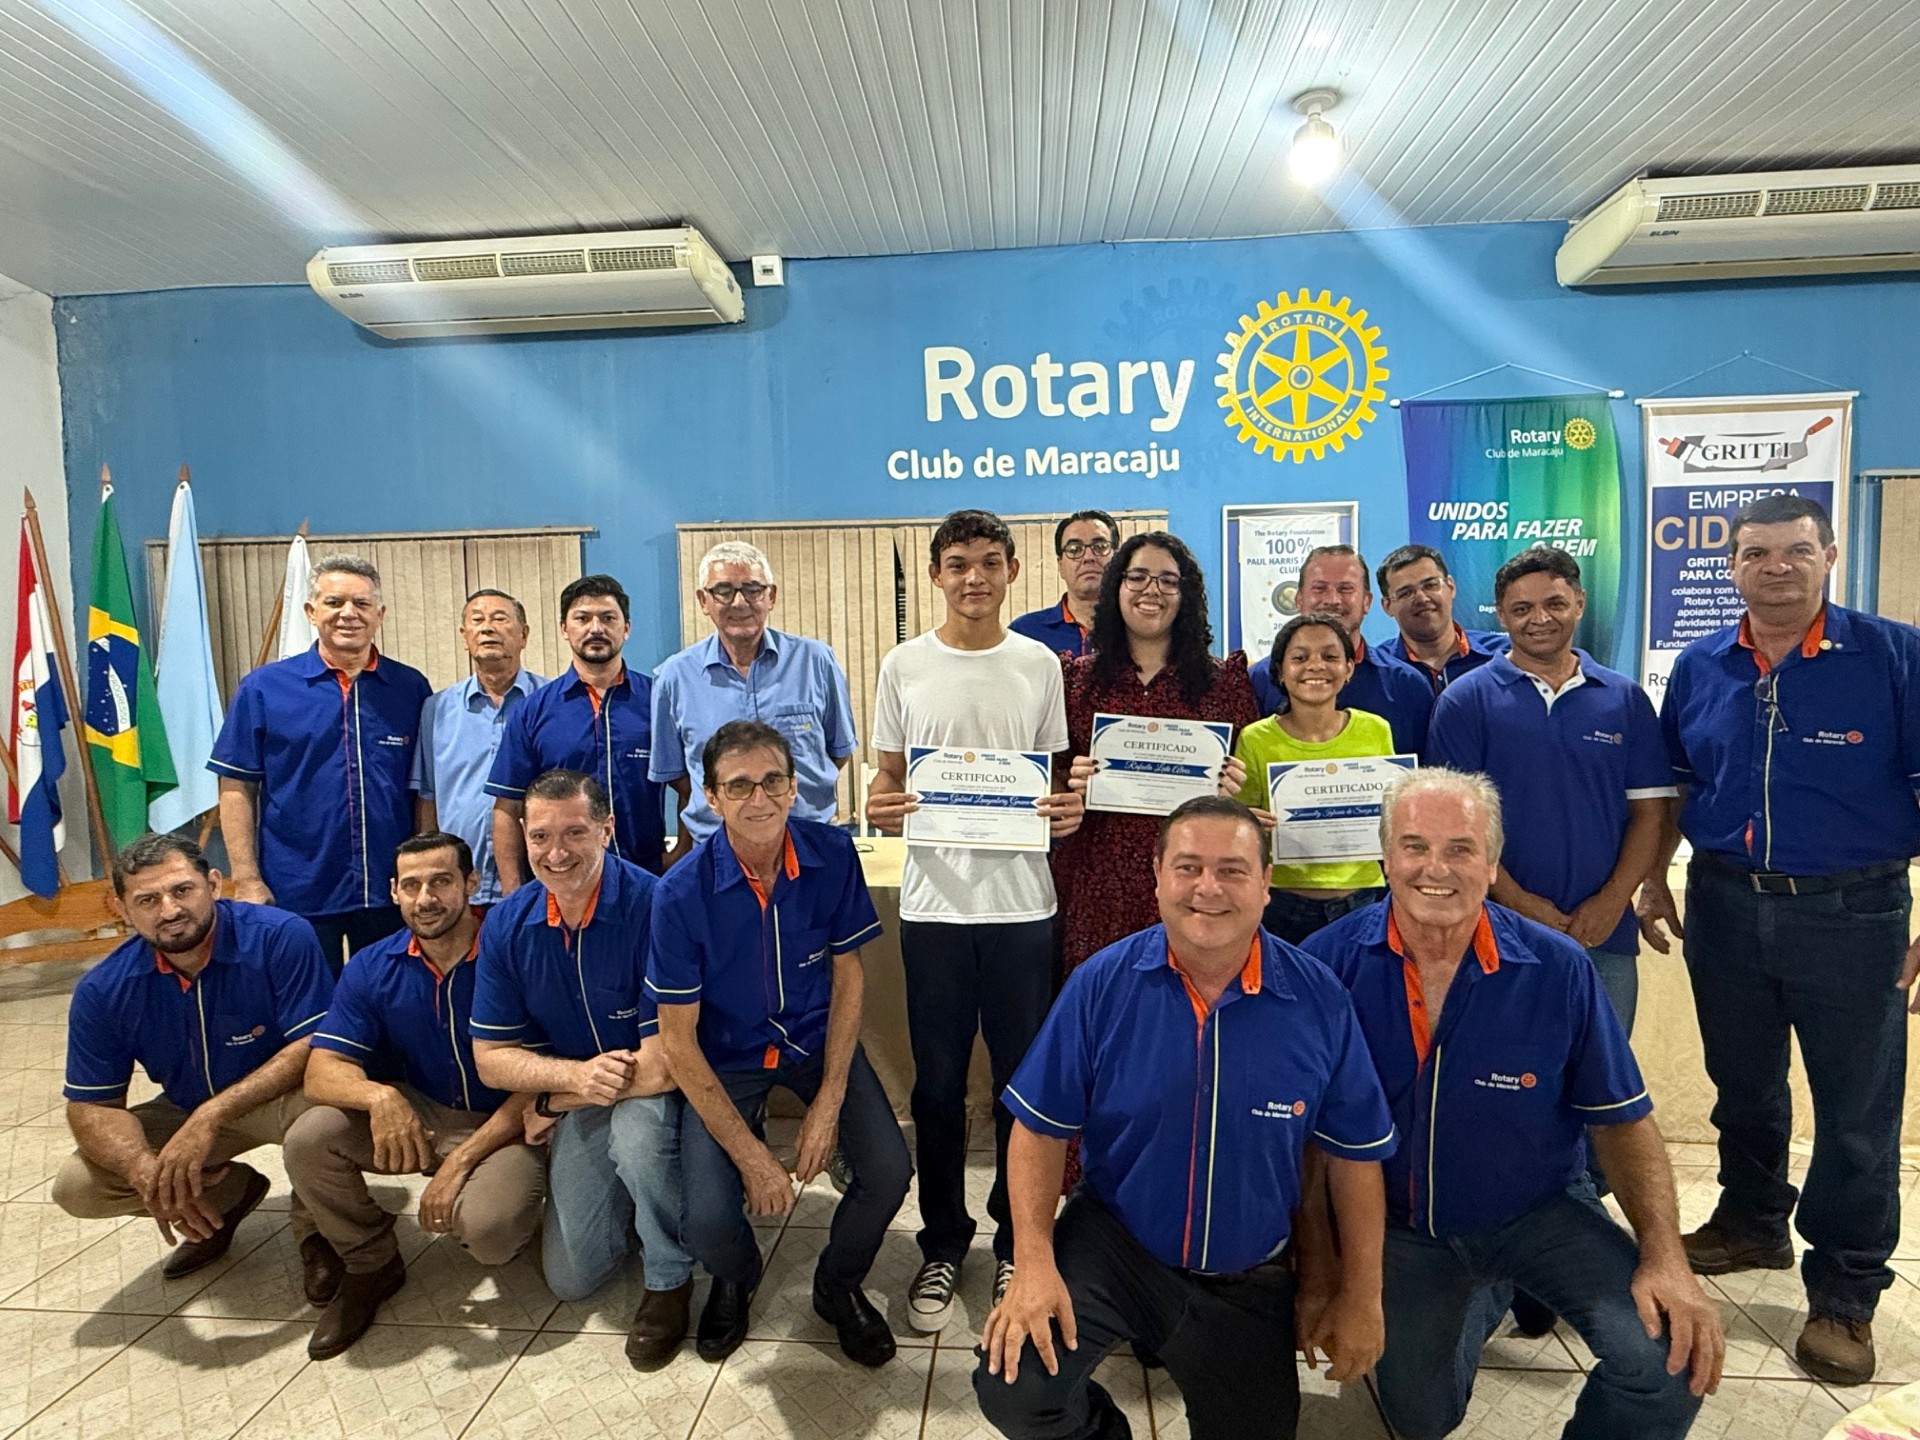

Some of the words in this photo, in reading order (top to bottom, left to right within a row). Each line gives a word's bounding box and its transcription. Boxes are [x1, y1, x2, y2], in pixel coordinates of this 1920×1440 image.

[1268, 313, 1338, 334] ROTARY
[924, 346, 1195, 432] Rotary
[1246, 405, 1354, 442] INTERNATIONAL
[1510, 429, 1562, 445] Rotary
[1485, 448, 1506, 459] Club
[1507, 448, 1520, 459] de
[1521, 446, 1564, 458] Maracaju
[1701, 442, 1791, 461] GRITTI
[887, 447, 964, 480] Club
[973, 448, 1015, 478] de
[1026, 442, 1180, 479] Maracaju
[1428, 501, 1510, 521] UNIDOS
[1451, 522, 1509, 541] PARA
[1512, 518, 1584, 540] FAZER
[1654, 515, 1730, 551] CID
[1265, 537, 1314, 555] 100%
[1246, 558, 1267, 566] PAUL
[1268, 556, 1299, 566] HARRIS
[1687, 557, 1727, 568] GRITTI
[1680, 570, 1713, 581] PARA
[1715, 569, 1734, 580] CO
[1671, 587, 1712, 596] colabora
[1713, 587, 1734, 595] com
[1684, 597, 1715, 607] Rotary
[1716, 596, 1739, 605] Club
[1677, 607, 1720, 617] apoiando
[1722, 606, 1748, 617] proje
[1674, 618, 1721, 628] atividades
[1818, 731, 1846, 741] Rotary
[1123, 740, 1197, 754] CERTIFICADO
[941, 771, 1017, 785] CERTIFICADO
[1304, 782, 1384, 796] CERTIFICADO
[1491, 1072, 1520, 1085] Rotary
[1267, 1101, 1292, 1112] Rotary
